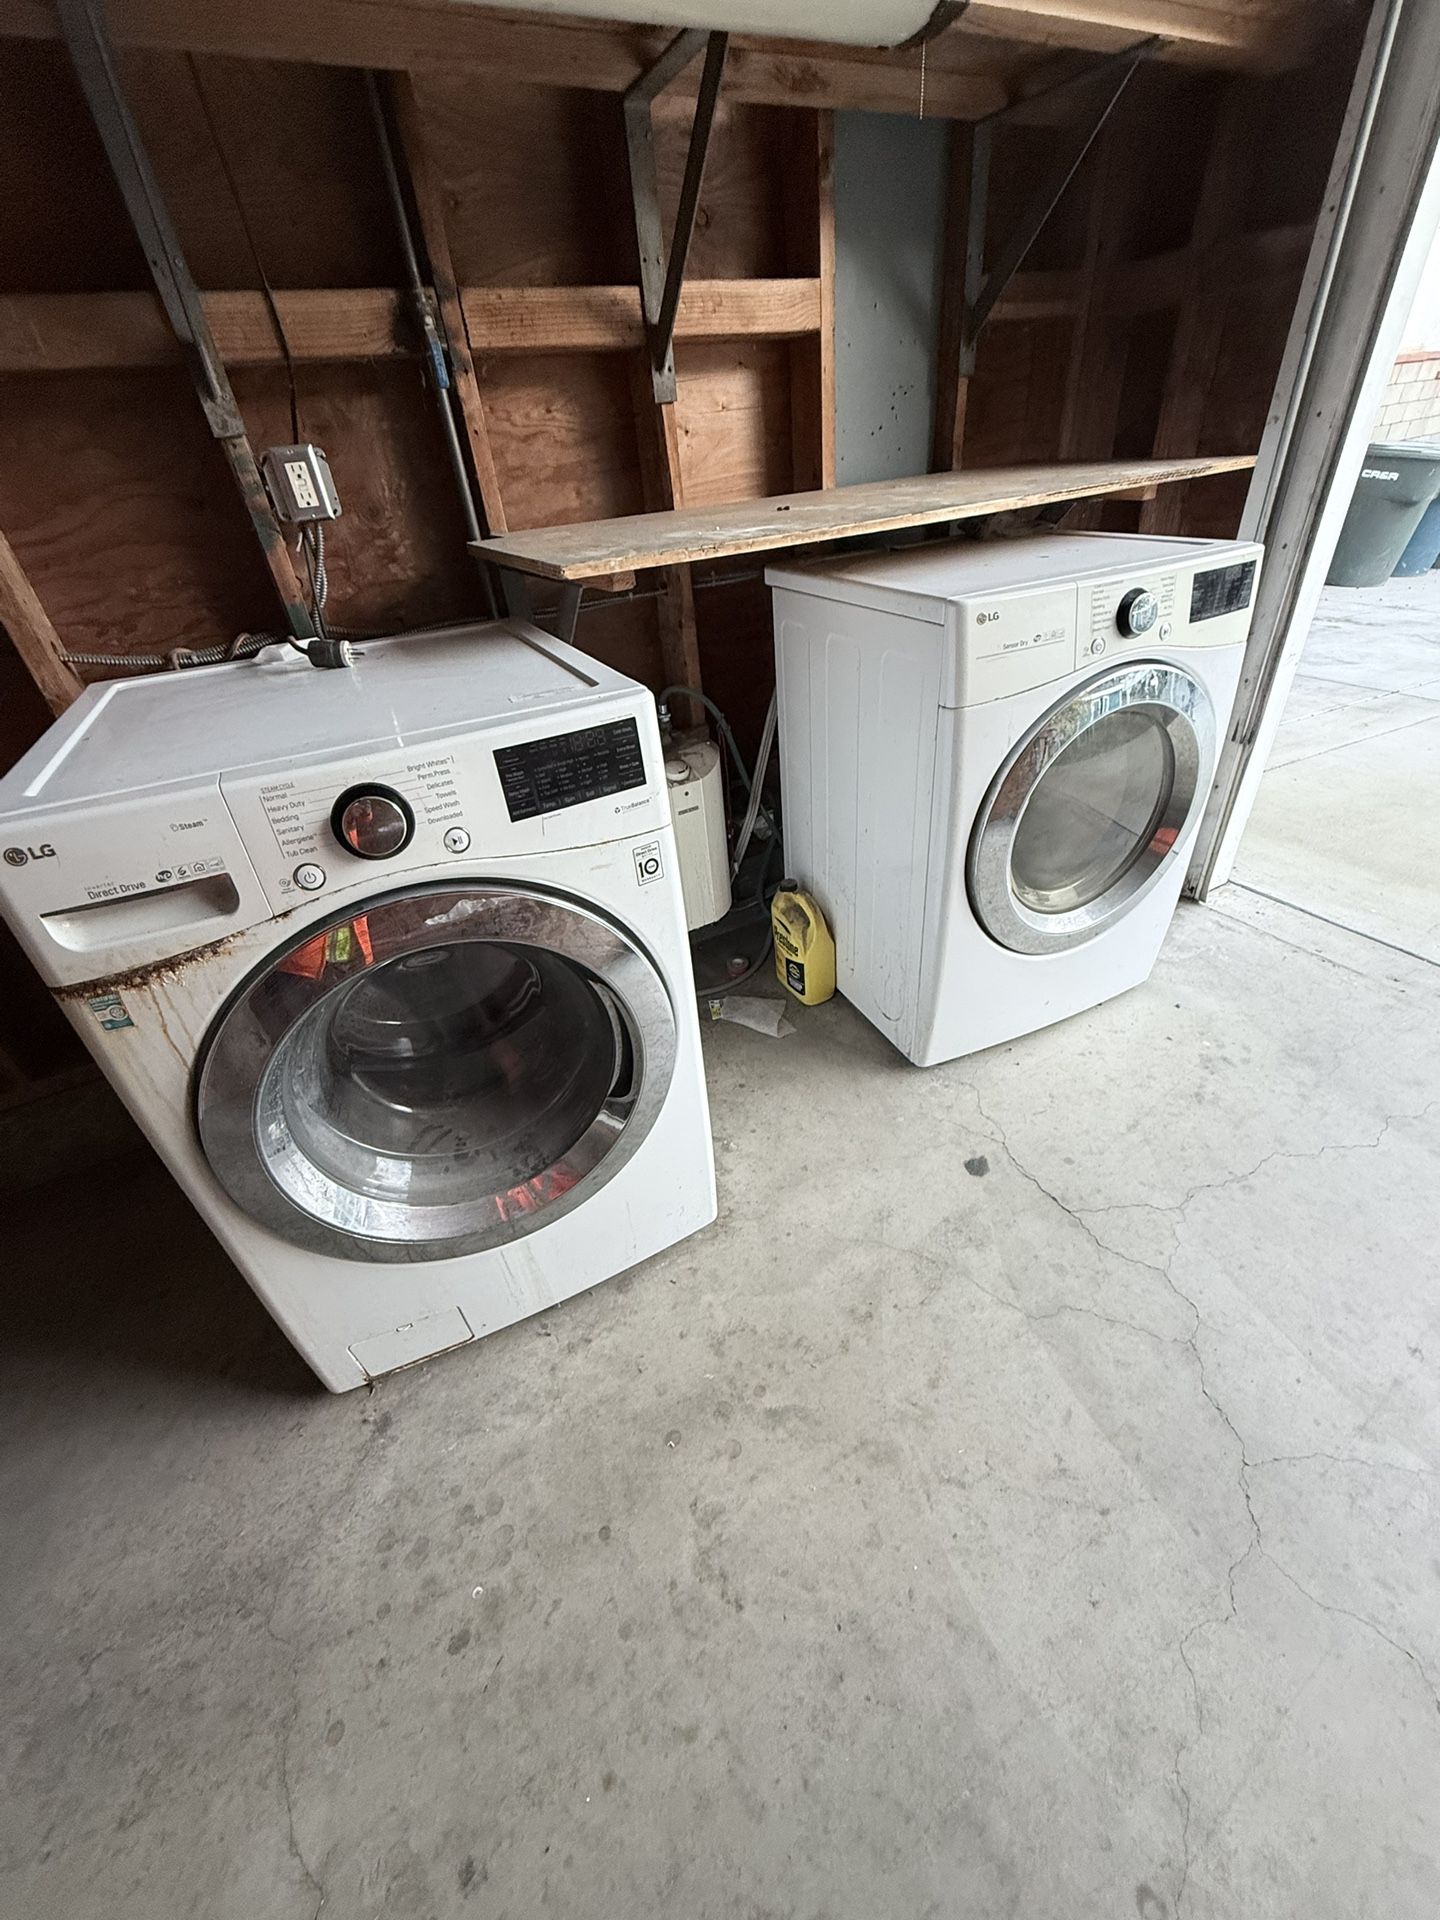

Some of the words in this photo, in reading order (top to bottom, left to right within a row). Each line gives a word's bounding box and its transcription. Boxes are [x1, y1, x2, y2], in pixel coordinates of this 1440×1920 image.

[988, 611, 1000, 622] LG
[406, 763, 426, 772] Bright
[426, 780, 454, 790] Delicates
[262, 792, 288, 802] Normal
[435, 790, 457, 799] Towels
[267, 804, 288, 813] Heavy
[288, 801, 306, 809] Duty
[423, 804, 443, 813] Speed
[443, 800, 461, 809] Wash
[271, 814, 300, 825] Bedding
[427, 811, 463, 824] Downloaded
[276, 825, 305, 836] Sanitary
[27, 843, 56, 860] LG
[299, 846, 318, 855] Clean
[638, 857, 660, 879] 10
[87, 887, 119, 900] Direct
[119, 881, 147, 893] Drive
